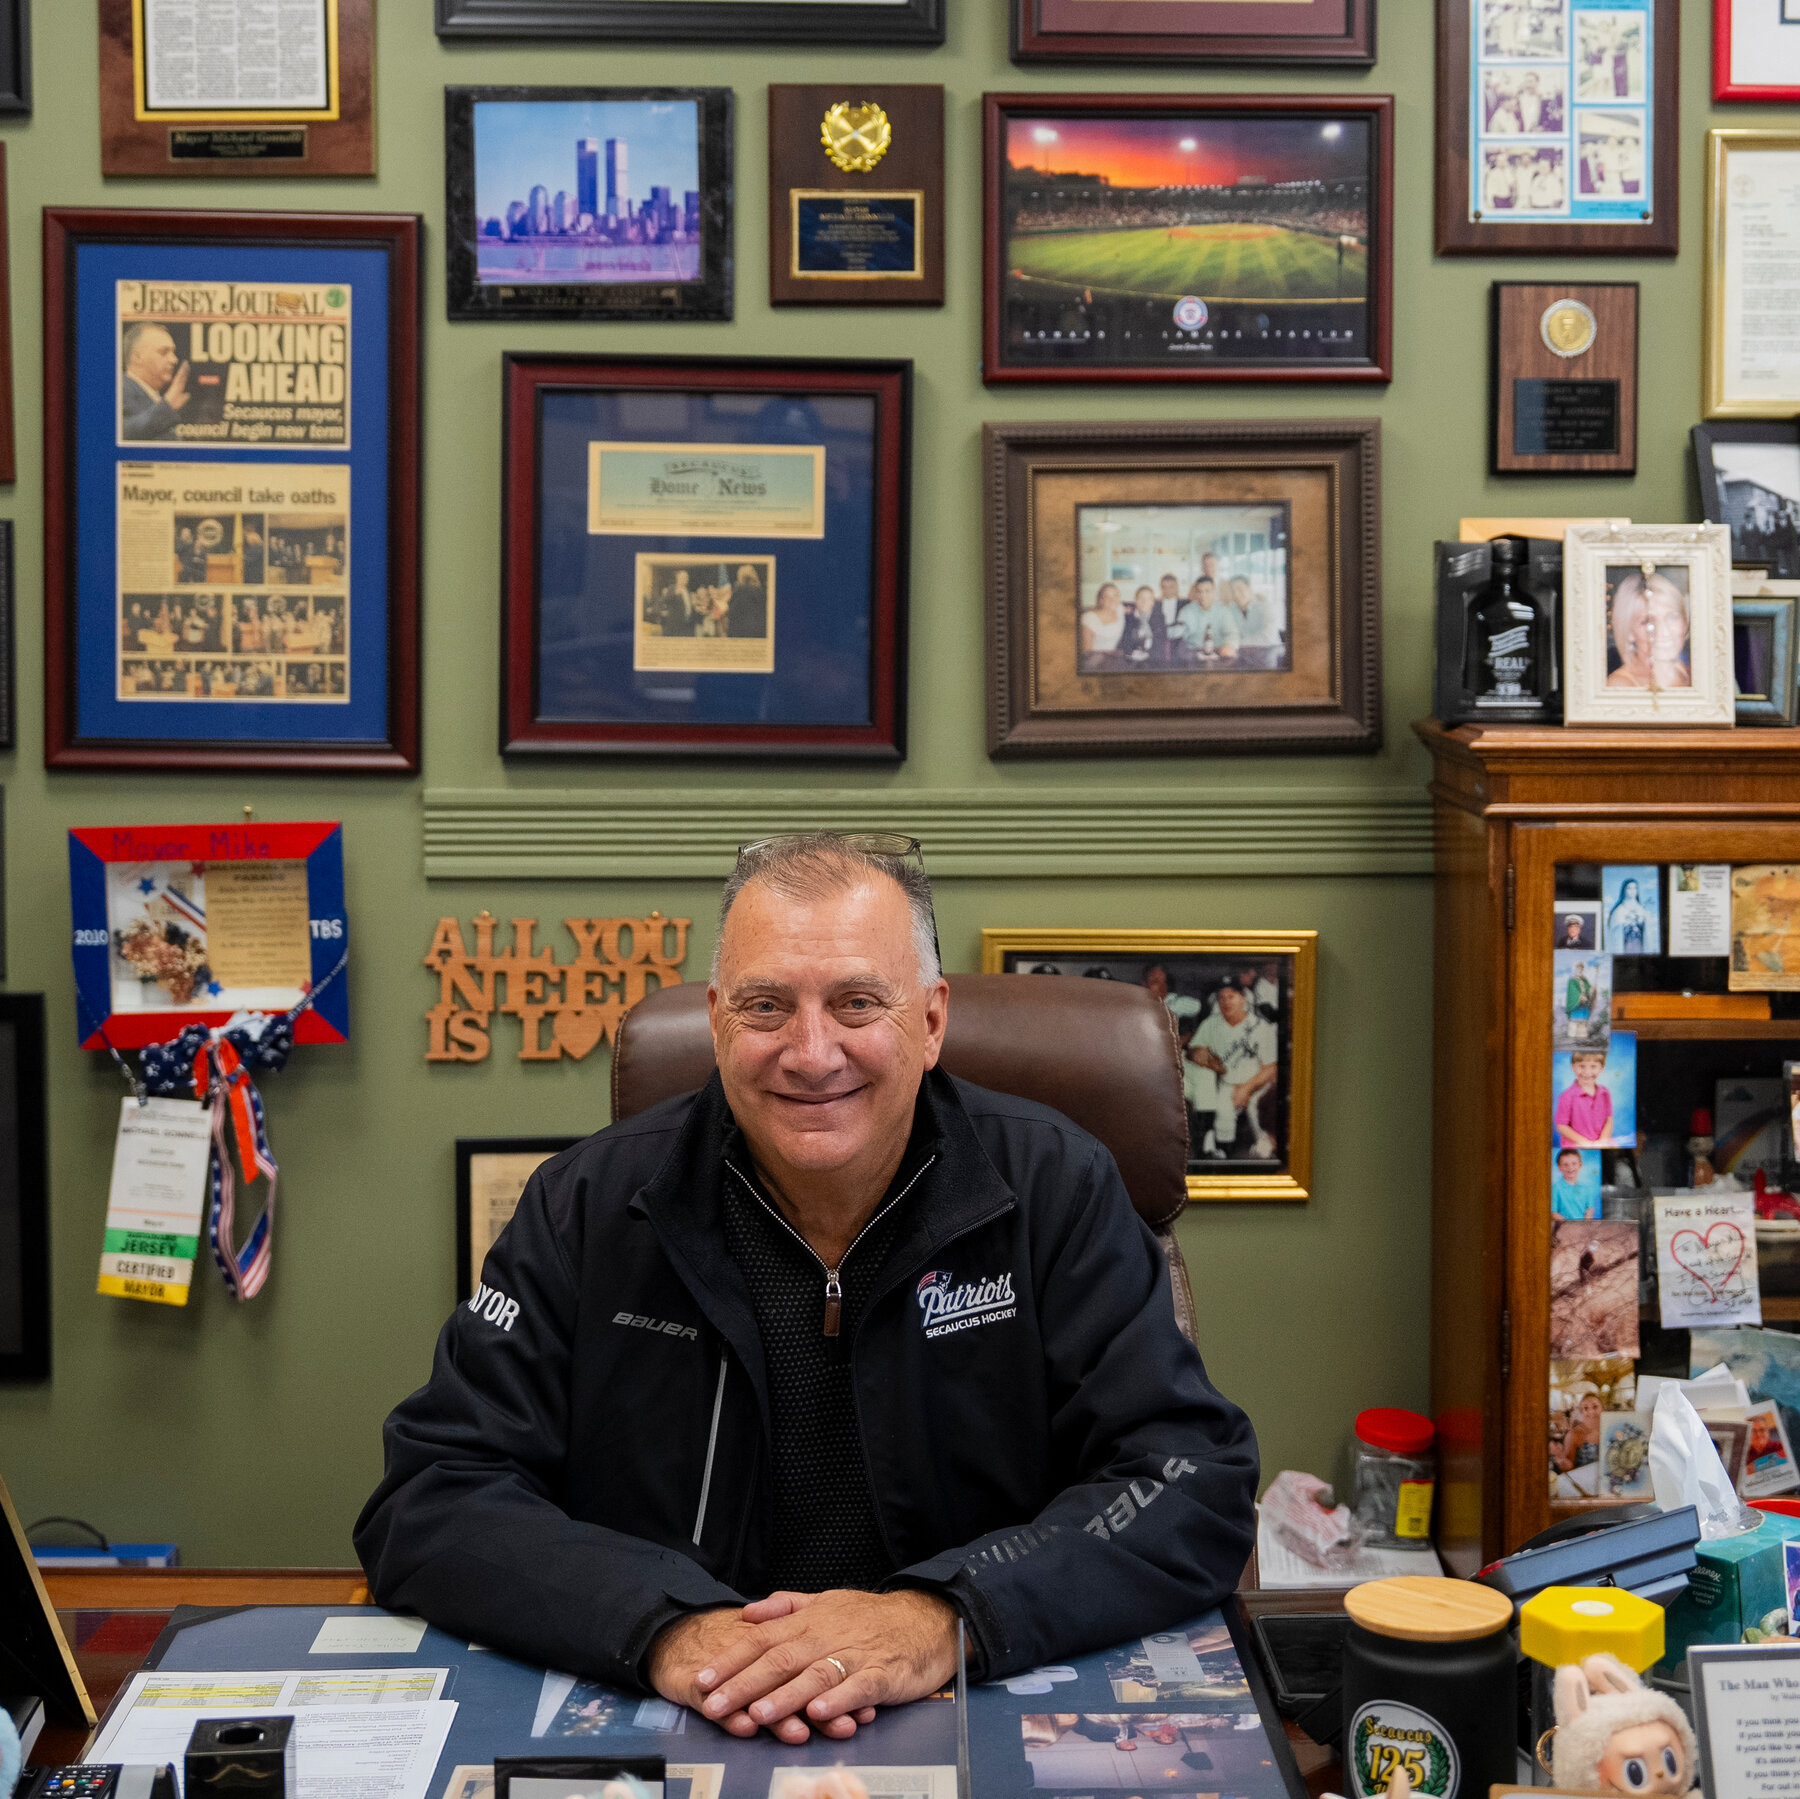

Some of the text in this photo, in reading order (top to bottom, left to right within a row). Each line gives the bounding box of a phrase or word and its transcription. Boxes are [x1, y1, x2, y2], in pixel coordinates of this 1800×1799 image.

[133, 282, 216, 315] JERSEY
[190, 322, 345, 364] LOOKING
[225, 363, 344, 404] AHEAD
[223, 403, 343, 424] Secaucus mayor,
[175, 422, 345, 442] council begin new term
[122, 485, 336, 506] Mayor, council take oaths
[718, 477, 768, 496] News
[112, 831, 271, 860] Mayor Mike
[74, 928, 109, 947] 2010
[309, 919, 343, 940] TBS
[424, 917, 691, 967] ALL YOU
[428, 957, 686, 1013] NEED
[425, 1008, 491, 1061] IS
[120, 1239, 179, 1256] JERSEY
[116, 1259, 177, 1279] CERTIFIED
[123, 1279, 166, 1299] MAYOR
[918, 1272, 1016, 1327] Patriots
[467, 1282, 520, 1332] AYOR
[925, 1307, 1017, 1339] SECAUCUS HOCKEY
[1083, 1457, 1198, 1540] BAUR
[1719, 1677, 1800, 1691] The Man Who
[1365, 1715, 1433, 1744] Secaucus
[1744, 1719, 1760, 1728] you
[1748, 1732, 1762, 1740] you
[1369, 1744, 1426, 1789] 125
[1753, 1770, 1768, 1780] you
